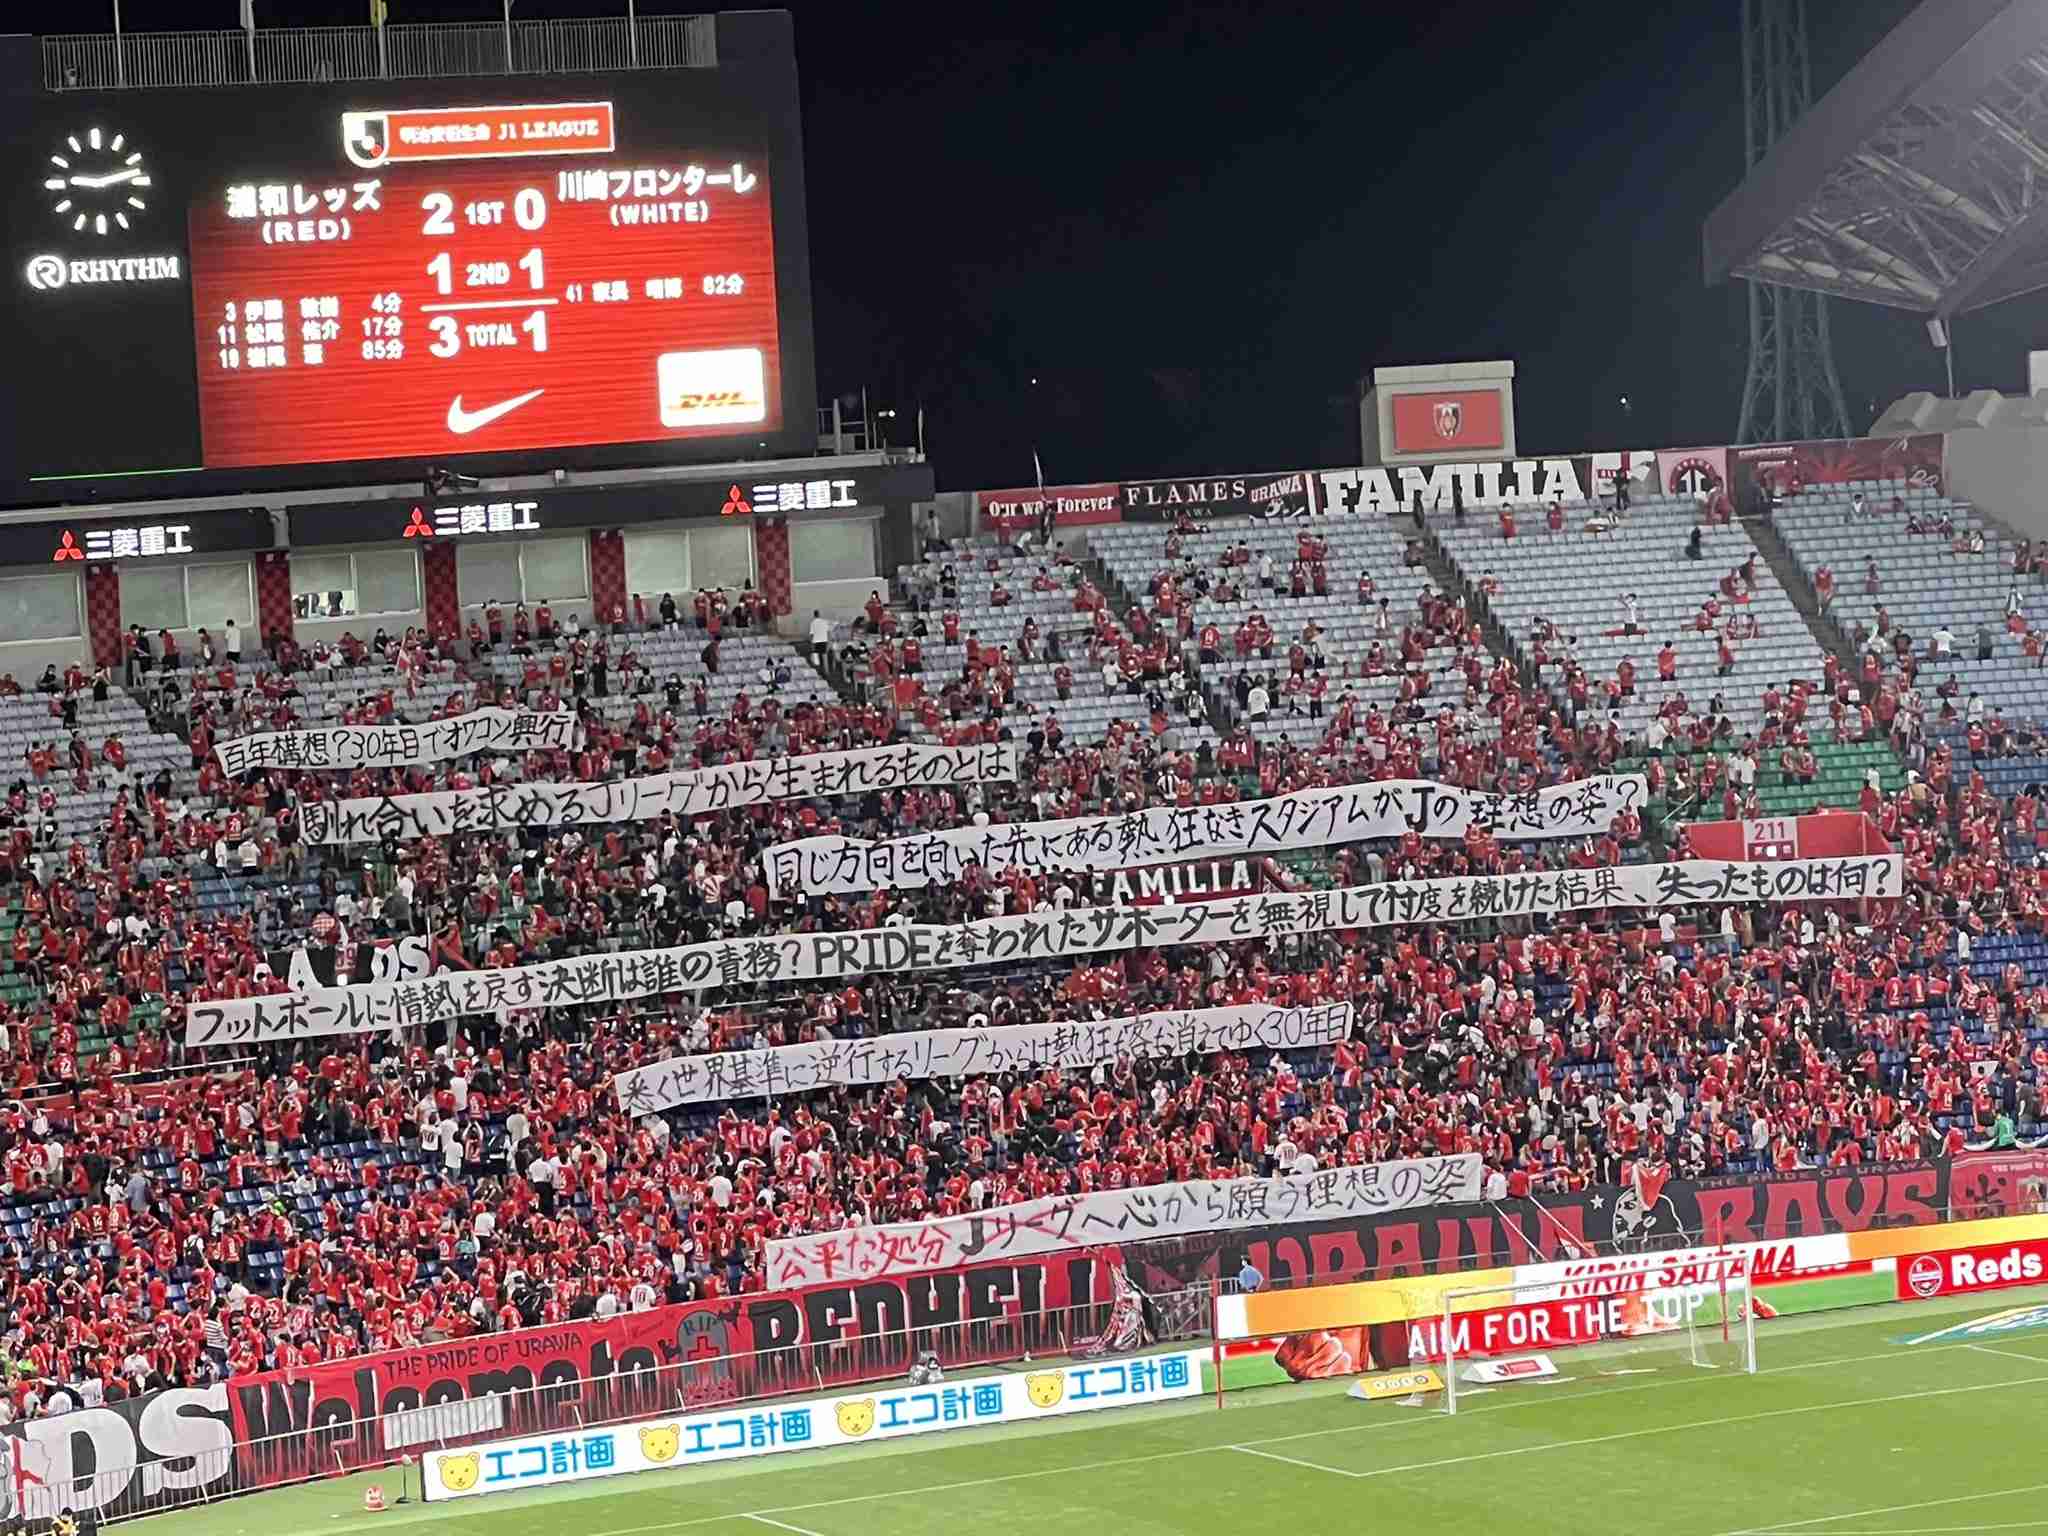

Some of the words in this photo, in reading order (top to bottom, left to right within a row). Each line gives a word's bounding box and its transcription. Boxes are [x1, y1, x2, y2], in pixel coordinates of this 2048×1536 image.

[522, 119, 599, 139] LEAGUE
[422, 193, 455, 236] 2
[465, 201, 504, 225] 1ST
[514, 188, 546, 231] 0
[610, 200, 708, 226] (WHITE)
[262, 219, 352, 245] (RED)
[69, 256, 180, 283] RHYTHM
[427, 252, 452, 295] 1
[465, 262, 510, 286] 2ND
[519, 248, 544, 290] 1
[225, 301, 237, 322] 3
[217, 323, 237, 345] 11
[361, 316, 403, 337] 17分
[429, 316, 461, 358] 3
[465, 323, 517, 348] TOTAL
[522, 310, 547, 352] 1
[681, 392, 747, 408] DHL
[752, 480, 858, 512] 三菱重工
[1124, 479, 1248, 508] FLAMES
[1250, 474, 1303, 504] URAWA
[1320, 459, 1585, 514] FAMILIA
[434, 502, 541, 535] 三菱重工
[1056, 494, 1115, 514] Forever
[85, 525, 193, 560] 三菱重工
[1754, 820, 1785, 840] 211
[1951, 1247, 2042, 1286] Reds
[1409, 1317, 1470, 1359] AIM
[1485, 1308, 1551, 1348] FOR
[1563, 1298, 1626, 1339] THE
[1640, 1291, 1706, 1328] TOP
[384, 1358, 422, 1380] THE
[427, 1347, 478, 1373] PRIDE
[484, 1342, 510, 1366] OF
[516, 1331, 583, 1360] URAWA
[1069, 1355, 1188, 1400] エコ計画
[880, 1383, 1004, 1428] エコ計画
[685, 1409, 811, 1454] エコ計画
[486, 1433, 614, 1483] エコ計画
